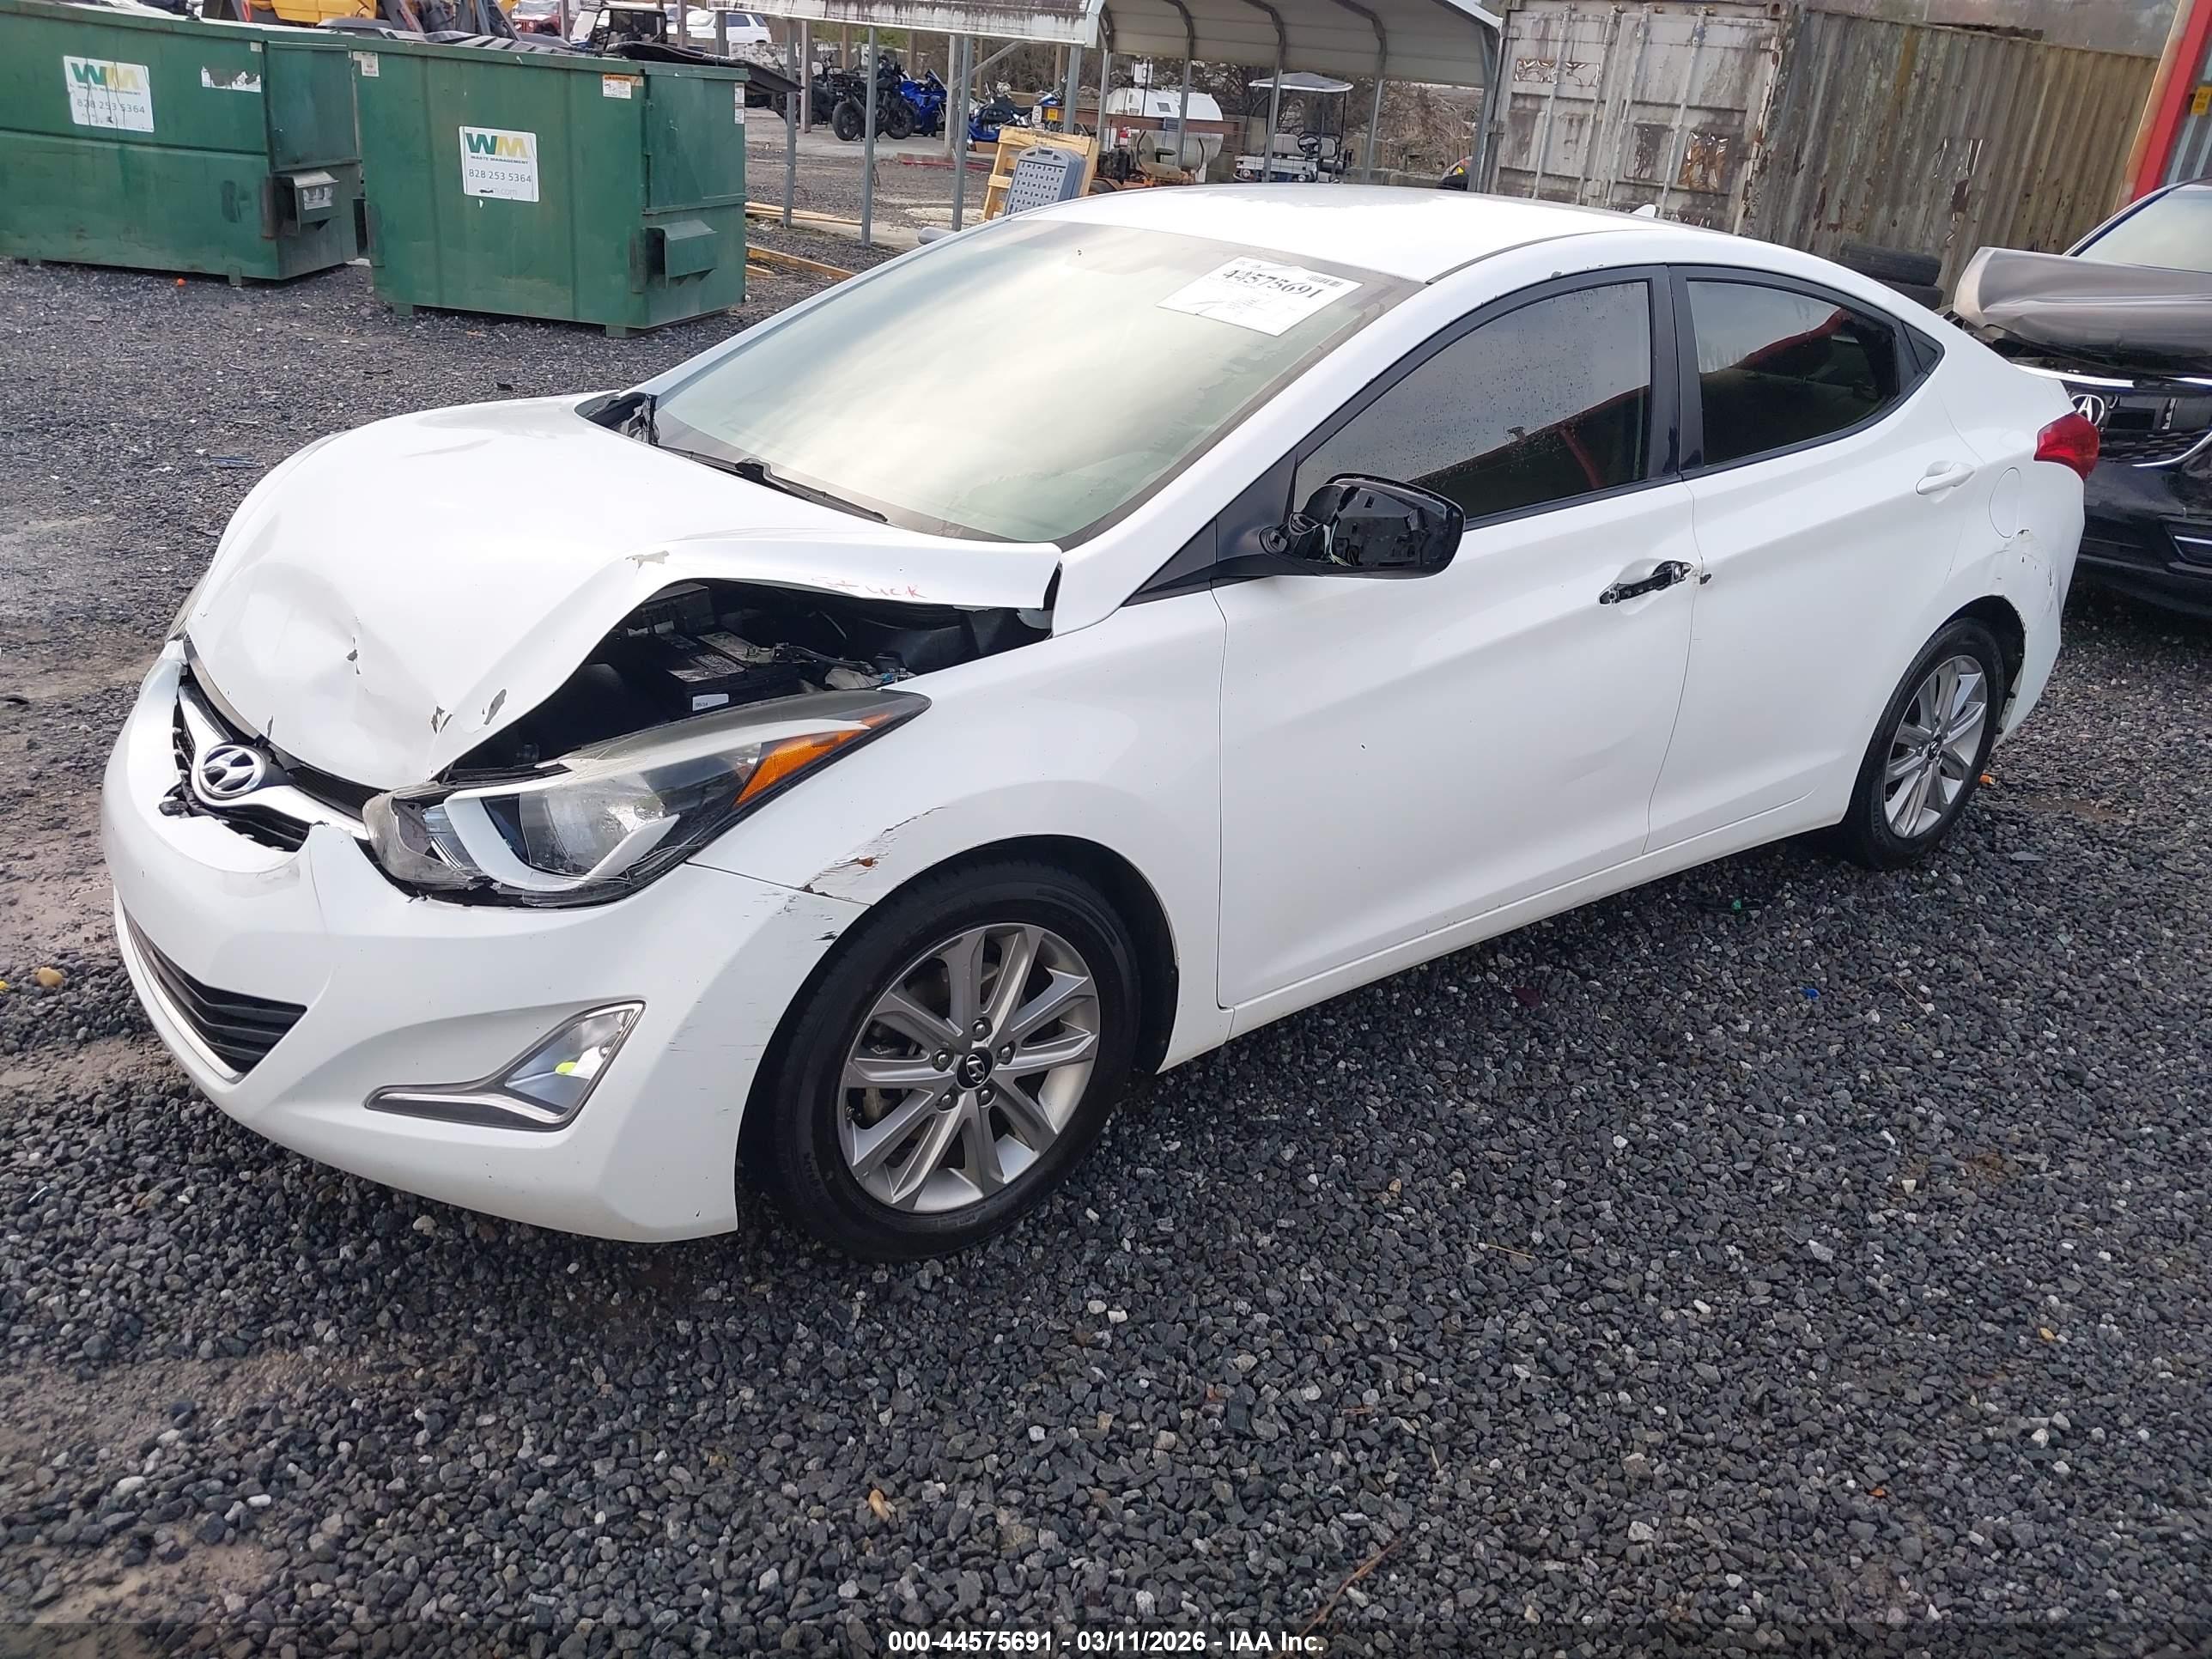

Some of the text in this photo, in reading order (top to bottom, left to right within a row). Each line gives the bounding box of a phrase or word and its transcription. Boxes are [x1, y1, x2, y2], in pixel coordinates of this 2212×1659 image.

[70, 62, 143, 90] WM
[119, 103, 145, 113] 5364
[465, 132, 529, 158] WM
[468, 168, 532, 183] 828 253 5364
[1222, 270, 1324, 298] 44575691
